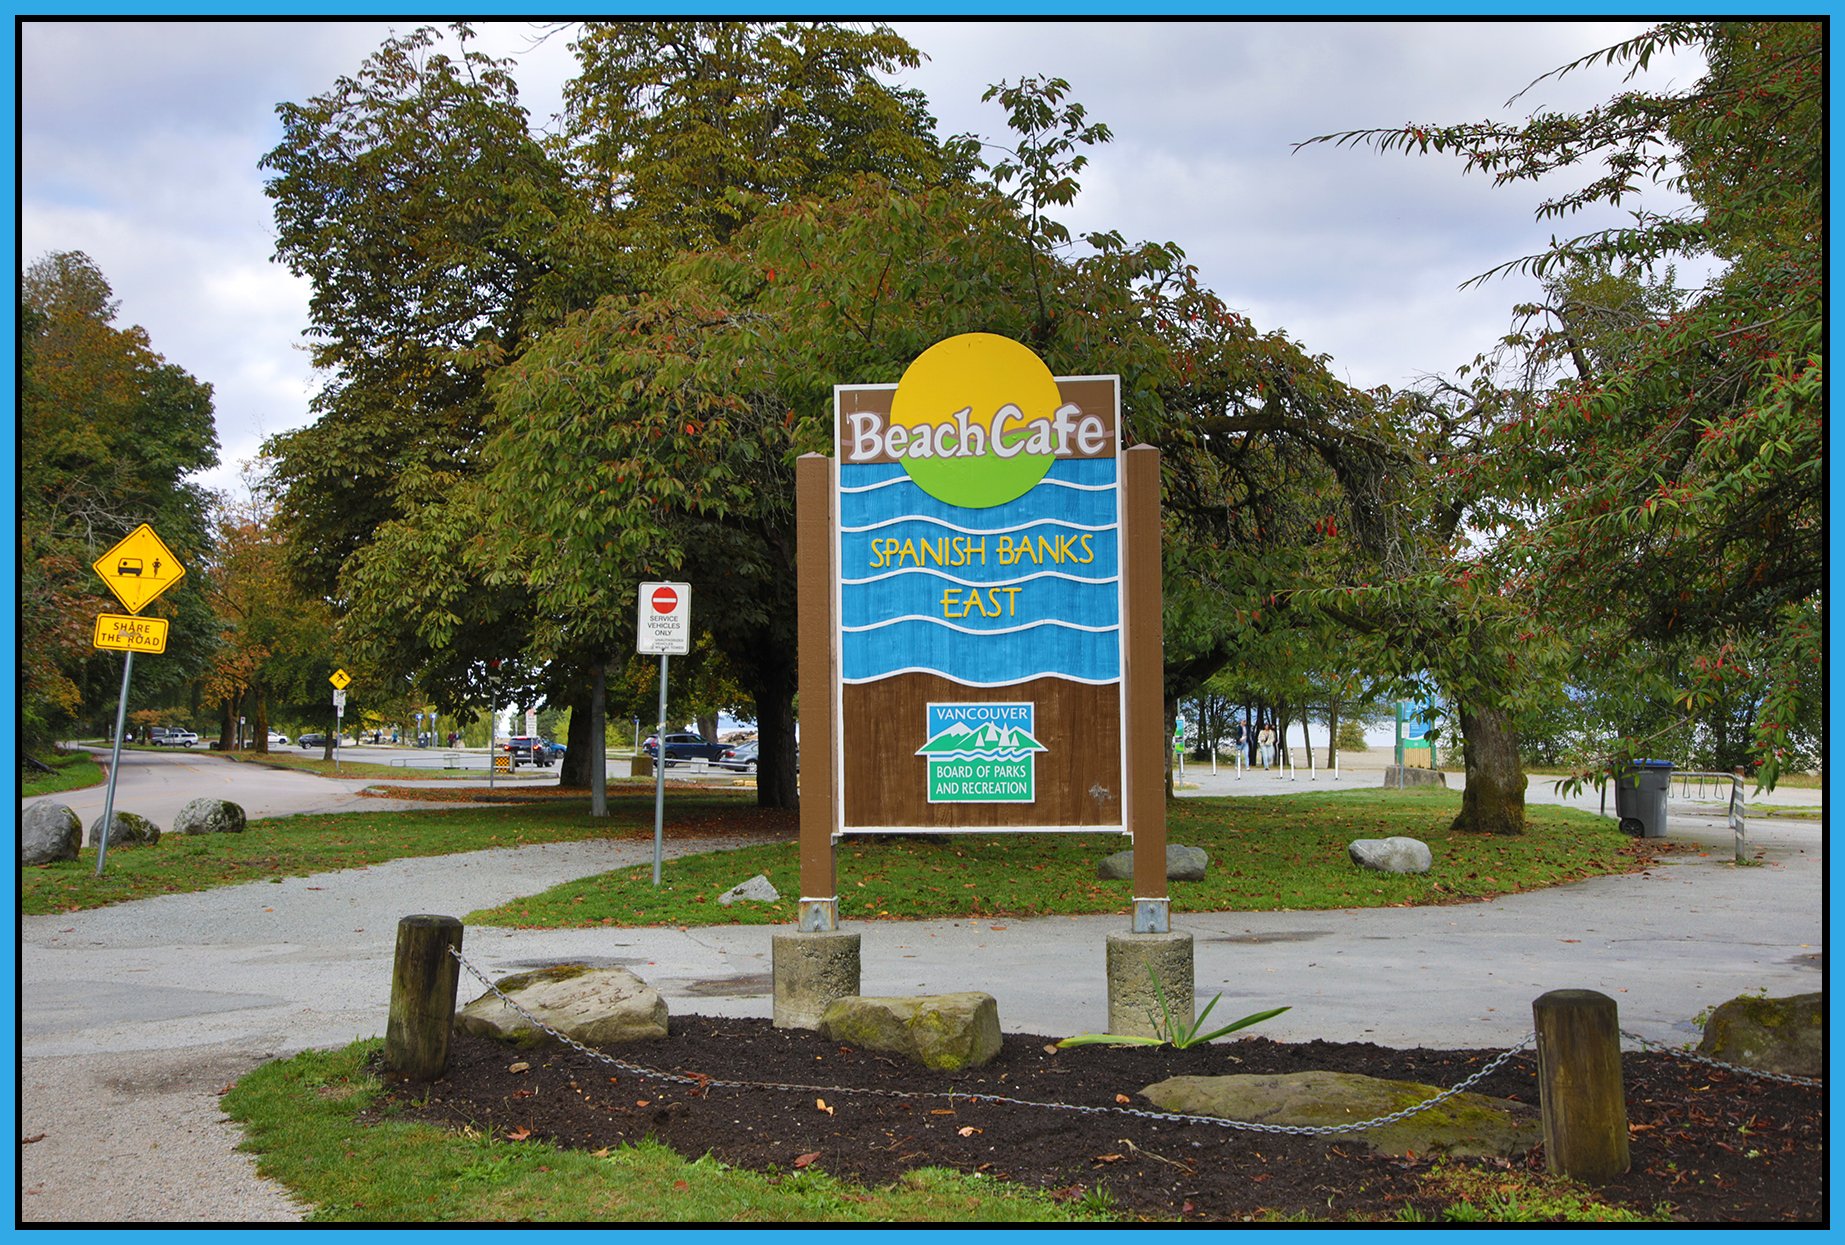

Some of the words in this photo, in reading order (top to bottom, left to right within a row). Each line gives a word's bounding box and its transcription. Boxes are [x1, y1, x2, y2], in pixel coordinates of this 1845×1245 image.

[869, 536, 986, 568] SPANISH
[996, 534, 1095, 565] BANKS
[939, 587, 1022, 618] EAST
[113, 622, 151, 633] SHARE
[101, 633, 121, 642] THE
[128, 635, 160, 646] ROAD
[937, 708, 1028, 720] VANCOUVER
[937, 766, 973, 778] BOARD
[976, 766, 991, 778] OF
[994, 766, 1026, 778] PARKS
[936, 782, 959, 794] AND
[962, 782, 1027, 794] RECREATION
